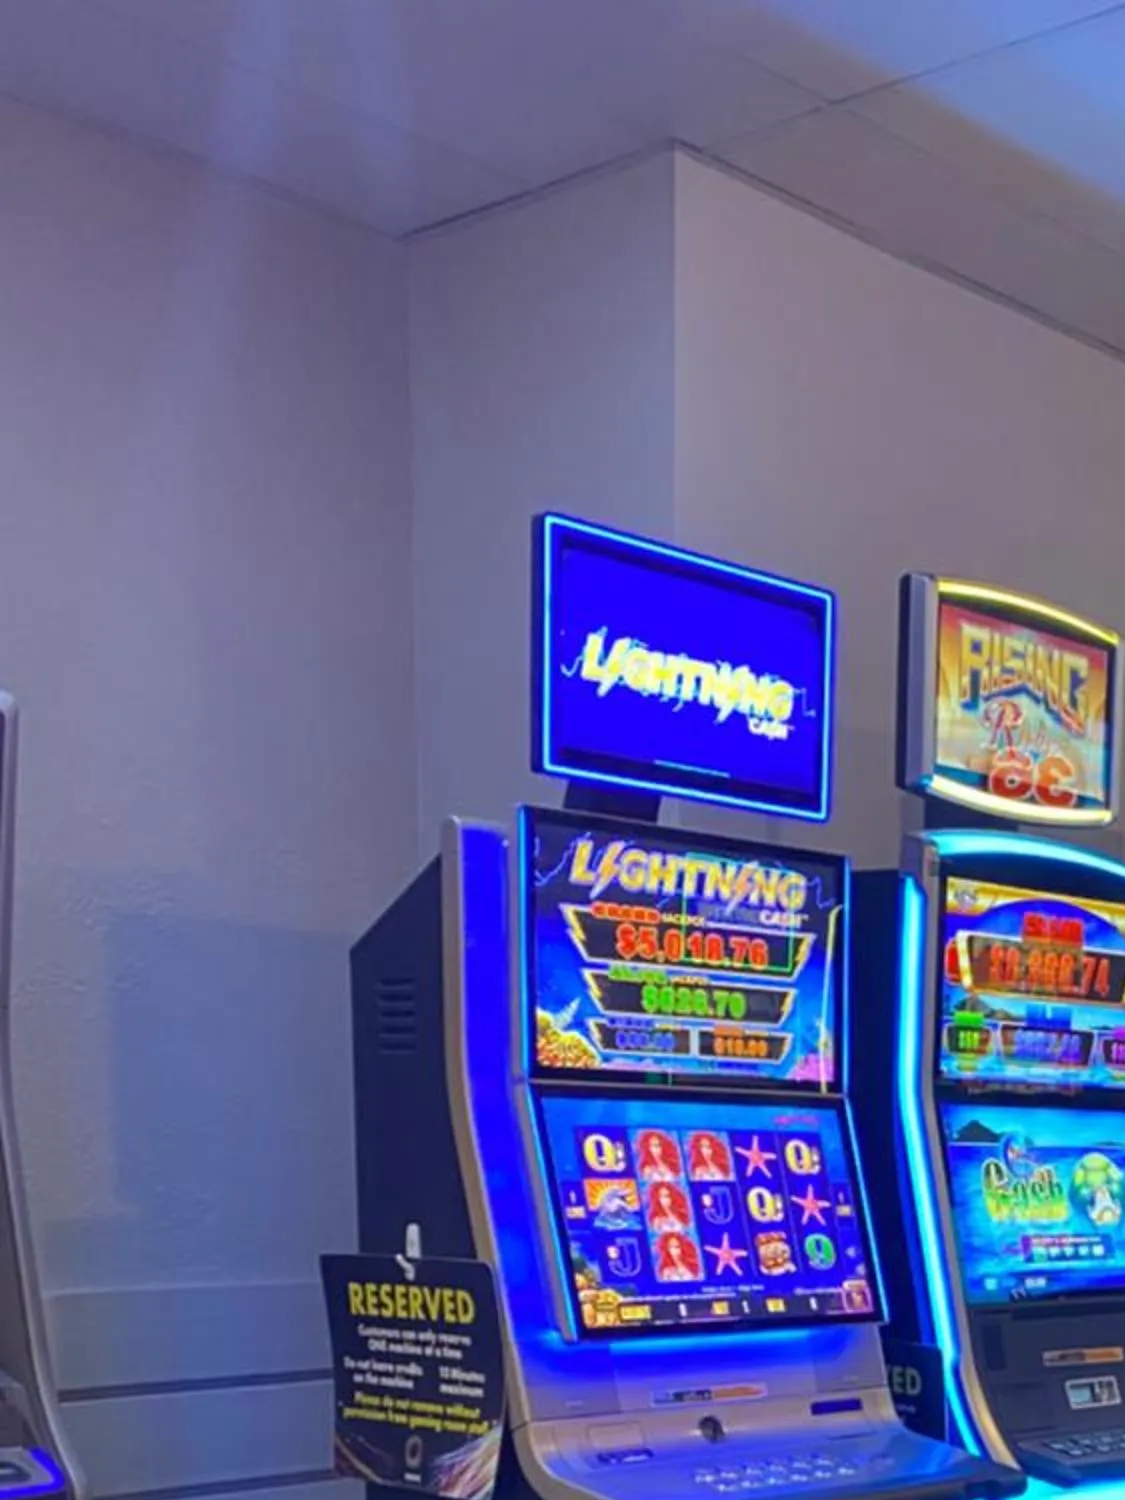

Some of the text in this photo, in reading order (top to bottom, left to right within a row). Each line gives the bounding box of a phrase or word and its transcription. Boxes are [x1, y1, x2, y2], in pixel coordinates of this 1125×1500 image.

[580, 626, 795, 722] LIGHTNING
[569, 839, 807, 913] LIGHTNING
[348, 1281, 475, 1325] RESERVED
